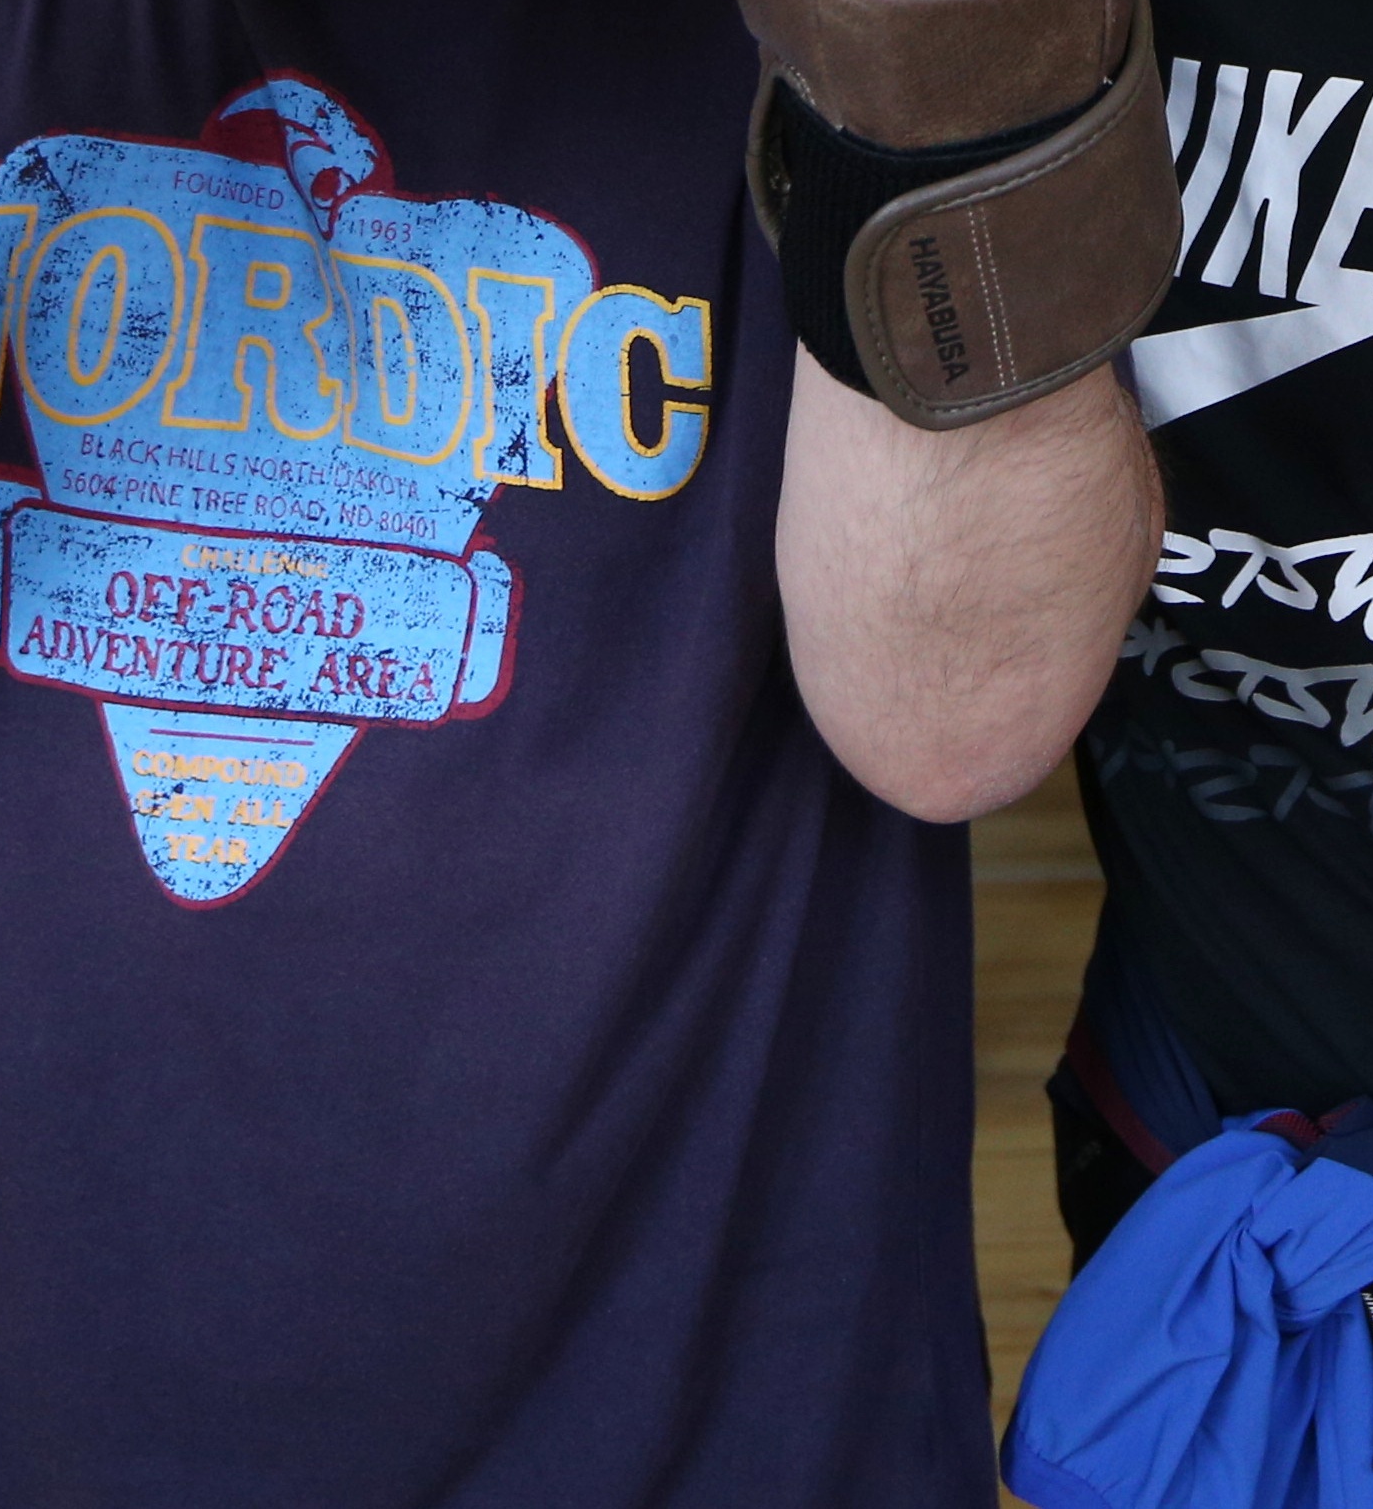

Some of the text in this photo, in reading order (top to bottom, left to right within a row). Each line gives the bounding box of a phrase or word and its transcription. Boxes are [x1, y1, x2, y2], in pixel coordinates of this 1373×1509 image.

[173, 170, 285, 210] FOUNDED
[356, 217, 413, 243] 1963
[908, 236, 970, 387] HAYABUSA
[80, 432, 421, 501] BLACK HILLS NORTH DAKOTA
[62, 468, 119, 498] 5604
[125, 478, 185, 508] PINE
[191, 486, 249, 515] TREE
[339, 501, 374, 528] ND
[180, 543, 330, 579] CHALLENGE
[105, 570, 366, 640] OFF-ROAD
[18, 614, 435, 702] ADVENTURE AREA
[132, 749, 308, 789] COMPOUND
[227, 798, 297, 829] ALL
[163, 832, 249, 866] YEAR
